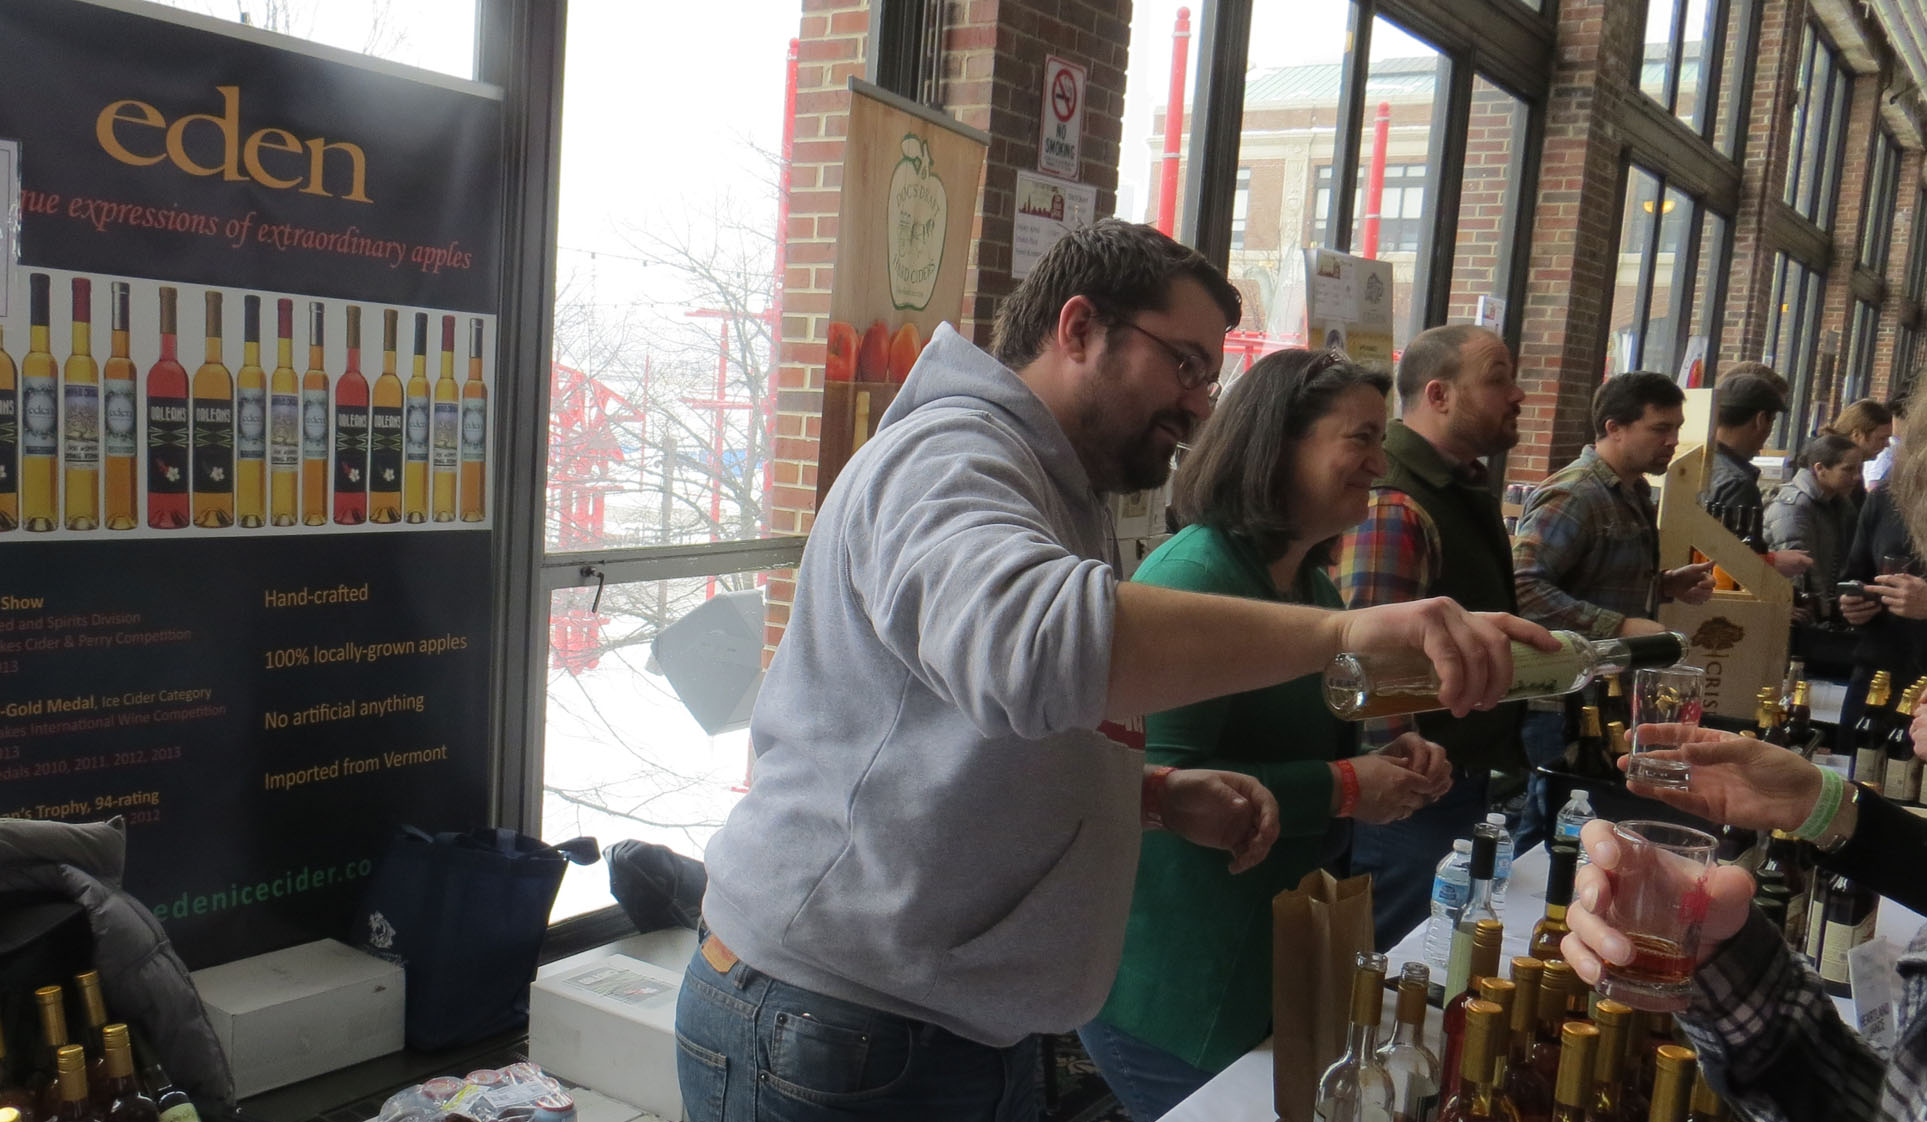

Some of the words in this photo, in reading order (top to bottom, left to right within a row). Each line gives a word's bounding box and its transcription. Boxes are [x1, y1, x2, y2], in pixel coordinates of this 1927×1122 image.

[96, 86, 374, 204] eden
[1056, 124, 1066, 140] NO
[1045, 137, 1075, 160] SMOKING
[68, 197, 219, 236] expressions
[225, 212, 257, 249] of
[258, 224, 407, 269] extraordinary
[411, 240, 473, 273] apples
[1, 595, 44, 610] Show
[264, 583, 369, 608] Hand-crafted
[18, 614, 43, 630] and
[47, 612, 88, 630] Spirits
[92, 611, 141, 626] Division
[25, 635, 59, 650] Cider
[63, 635, 75, 648] &
[79, 633, 113, 649] Perry
[115, 629, 193, 647] Competition
[265, 648, 309, 670] 100%
[314, 640, 415, 662] locally-grown
[419, 633, 468, 656] apples
[47, 695, 98, 713] Medal,
[102, 695, 121, 708] Ice
[123, 691, 156, 707] Cider
[159, 687, 212, 706] Category
[1702, 660, 1723, 714] CRIS
[31, 716, 115, 736] International
[118, 710, 150, 727] Wine
[153, 704, 227, 723] Competition
[264, 711, 288, 730] No
[293, 699, 356, 726] artificial
[360, 694, 425, 718] anything
[151, 746, 182, 761] 2013
[264, 759, 339, 791] Imported
[343, 757, 380, 776] from
[384, 744, 448, 769] Vermont
[36, 800, 91, 820] Trophy,
[95, 790, 160, 812] 94-rating
[130, 809, 161, 825] 2012
